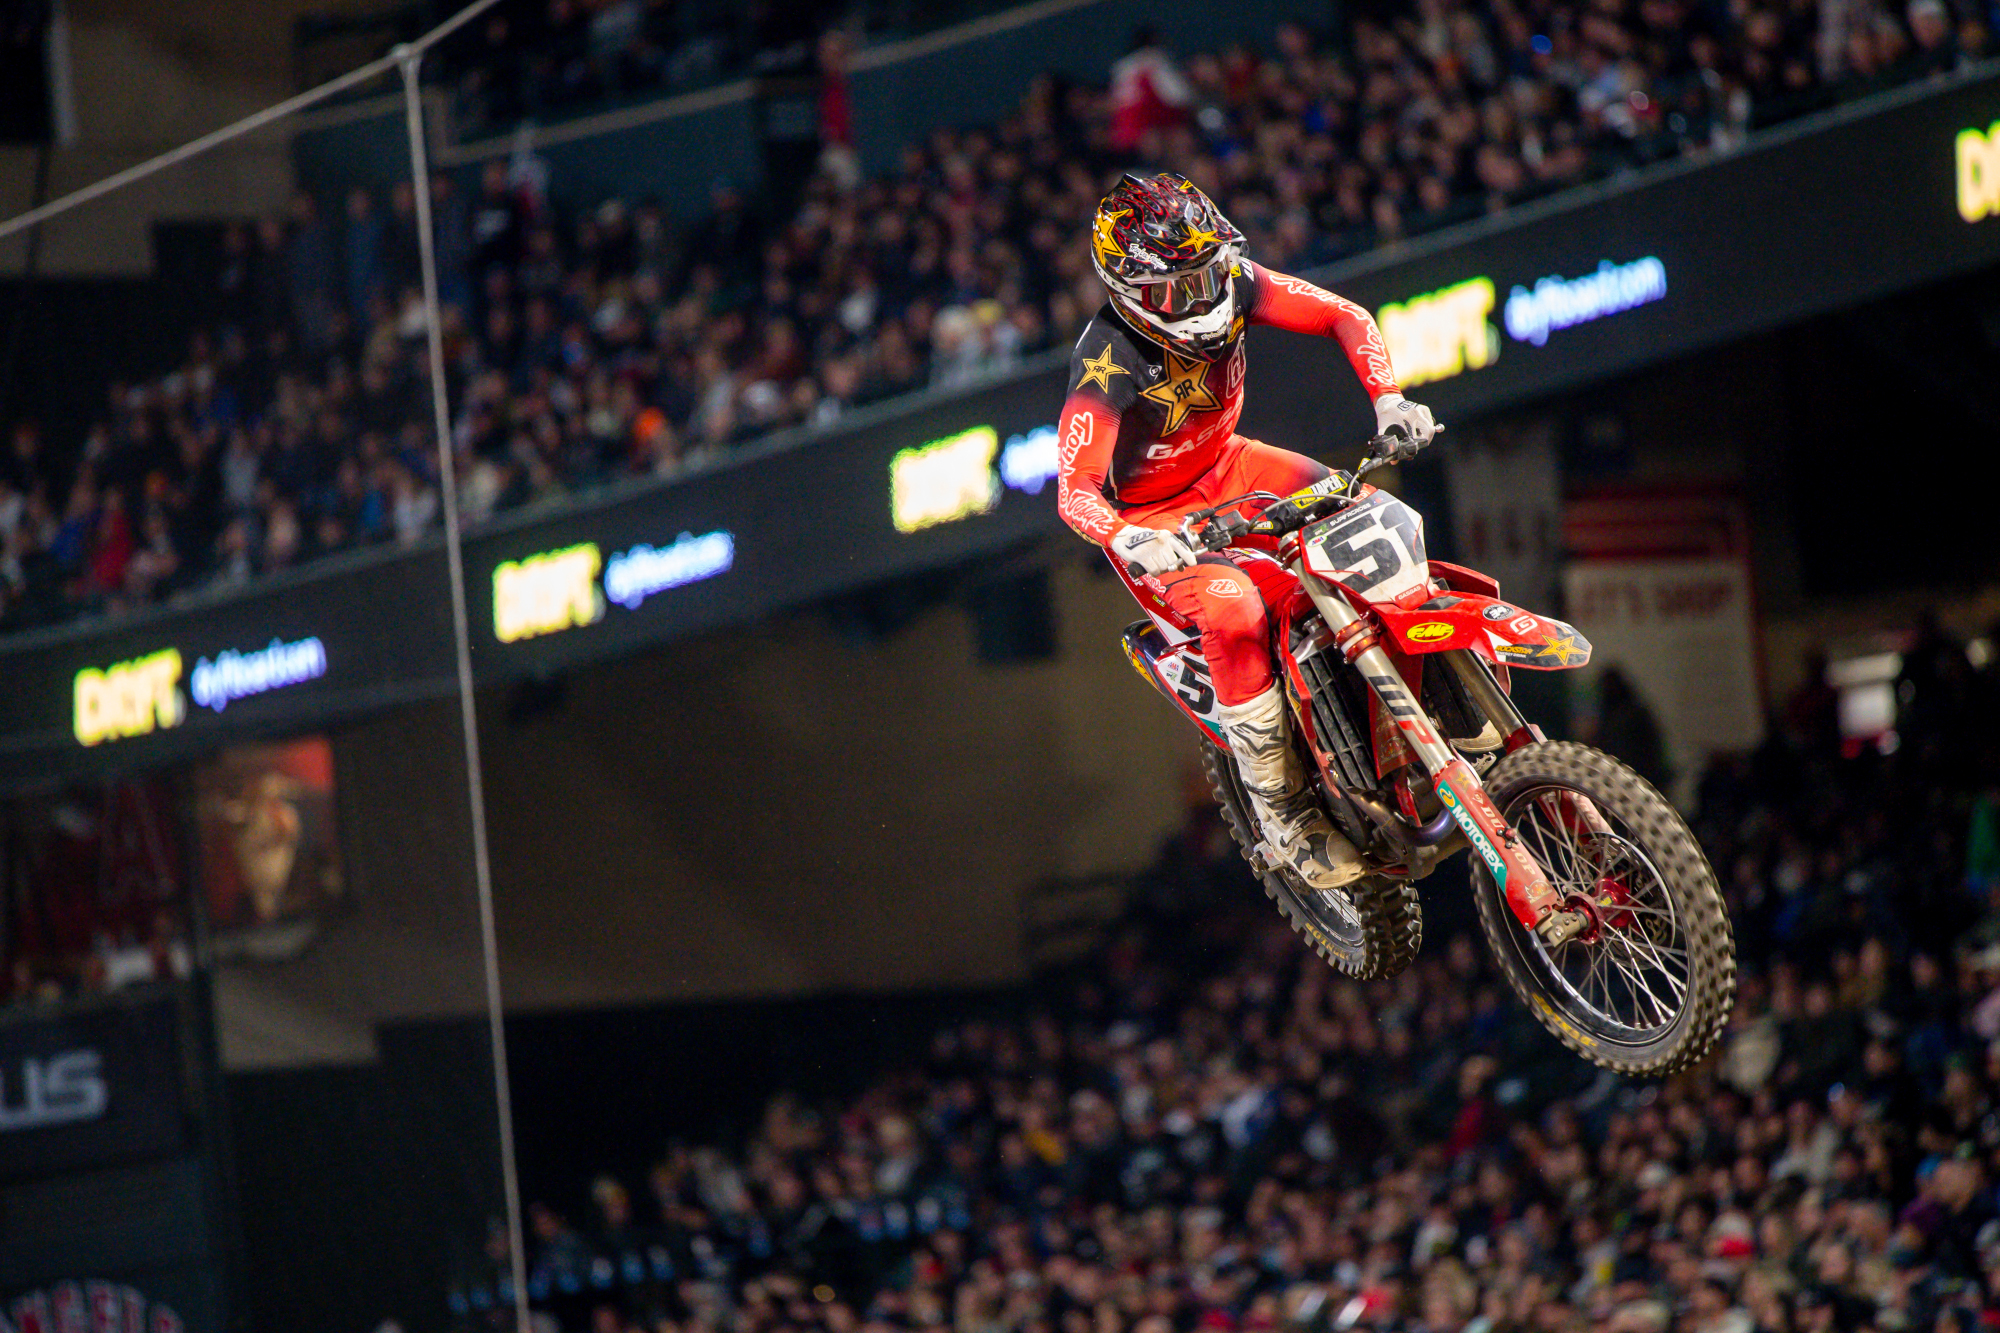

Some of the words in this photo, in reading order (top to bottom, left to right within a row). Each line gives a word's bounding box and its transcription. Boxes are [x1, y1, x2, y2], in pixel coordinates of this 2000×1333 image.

[1061, 411, 1093, 466] Troy
[1320, 500, 1425, 595] 51
[1397, 585, 1422, 600] GASGAS
[1406, 624, 1455, 640] FMF
[1494, 644, 1534, 655] ROCKSTAR
[1451, 804, 1506, 875] MOTOREX
[1480, 805, 1537, 876] DUOP
